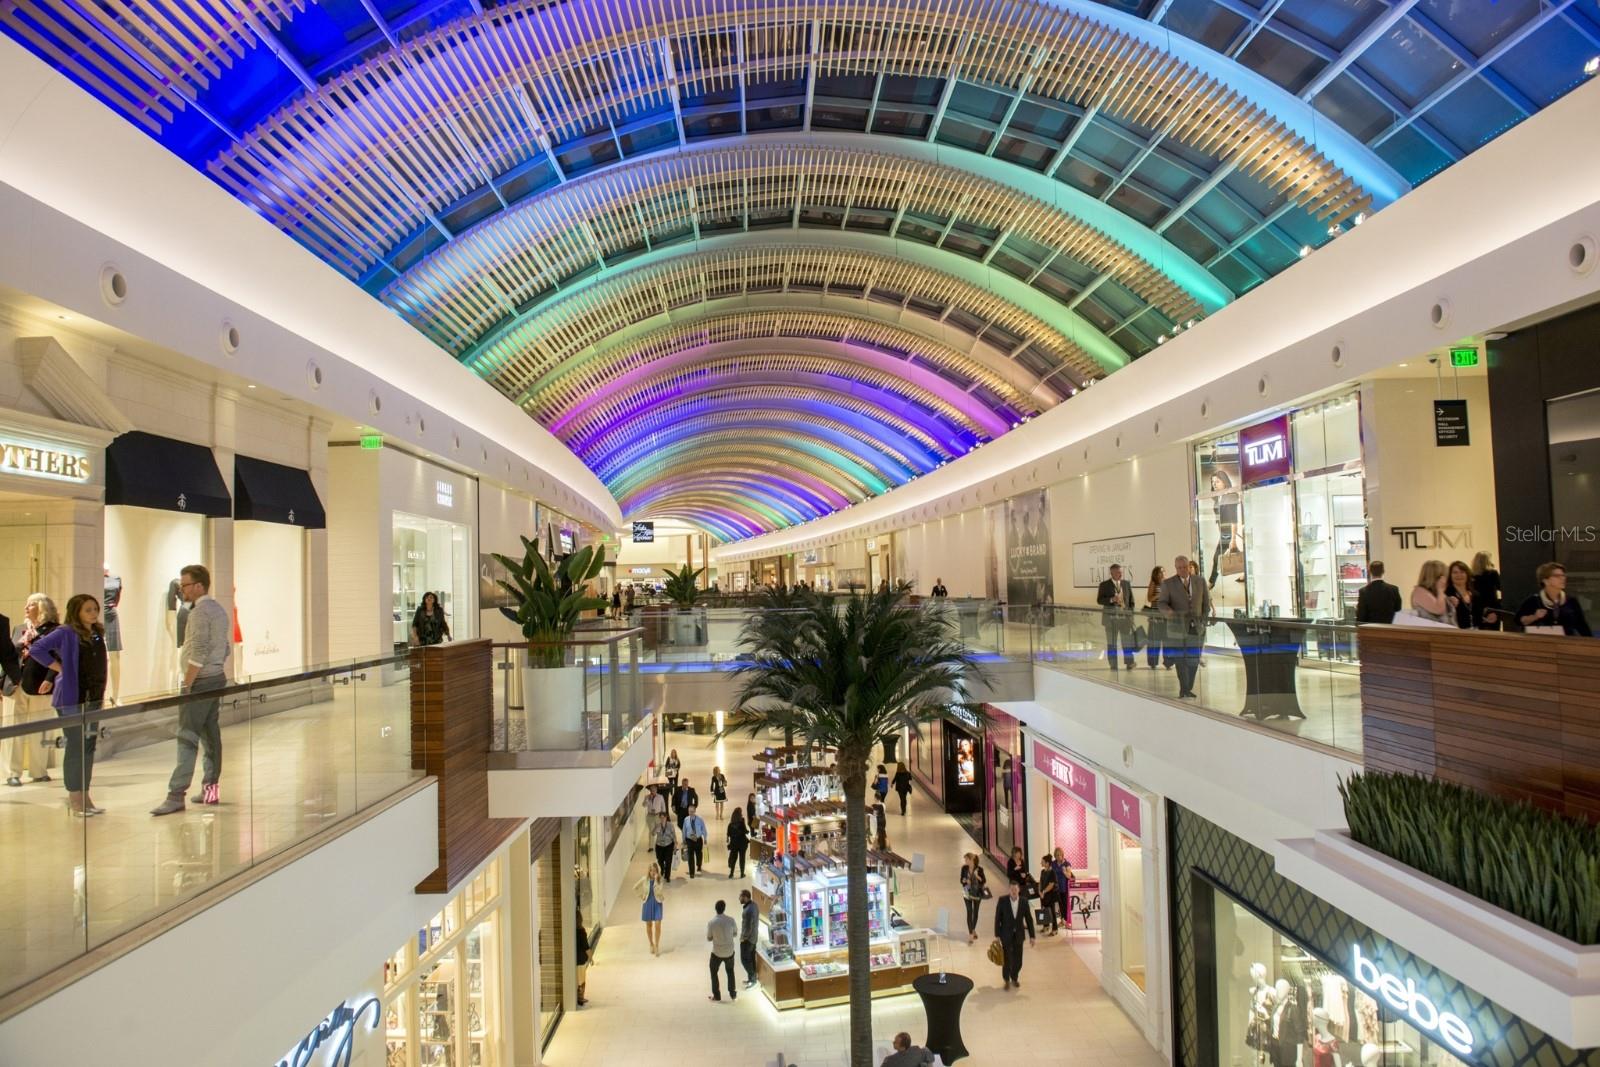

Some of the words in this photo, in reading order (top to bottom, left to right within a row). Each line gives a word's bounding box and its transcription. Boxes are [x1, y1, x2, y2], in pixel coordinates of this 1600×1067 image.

[1455, 351, 1473, 366] EXIT
[0, 443, 91, 479] THERS
[1391, 525, 1474, 549] TUMI
[1051, 756, 1073, 787] PINK
[1353, 943, 1474, 1055] bebe
